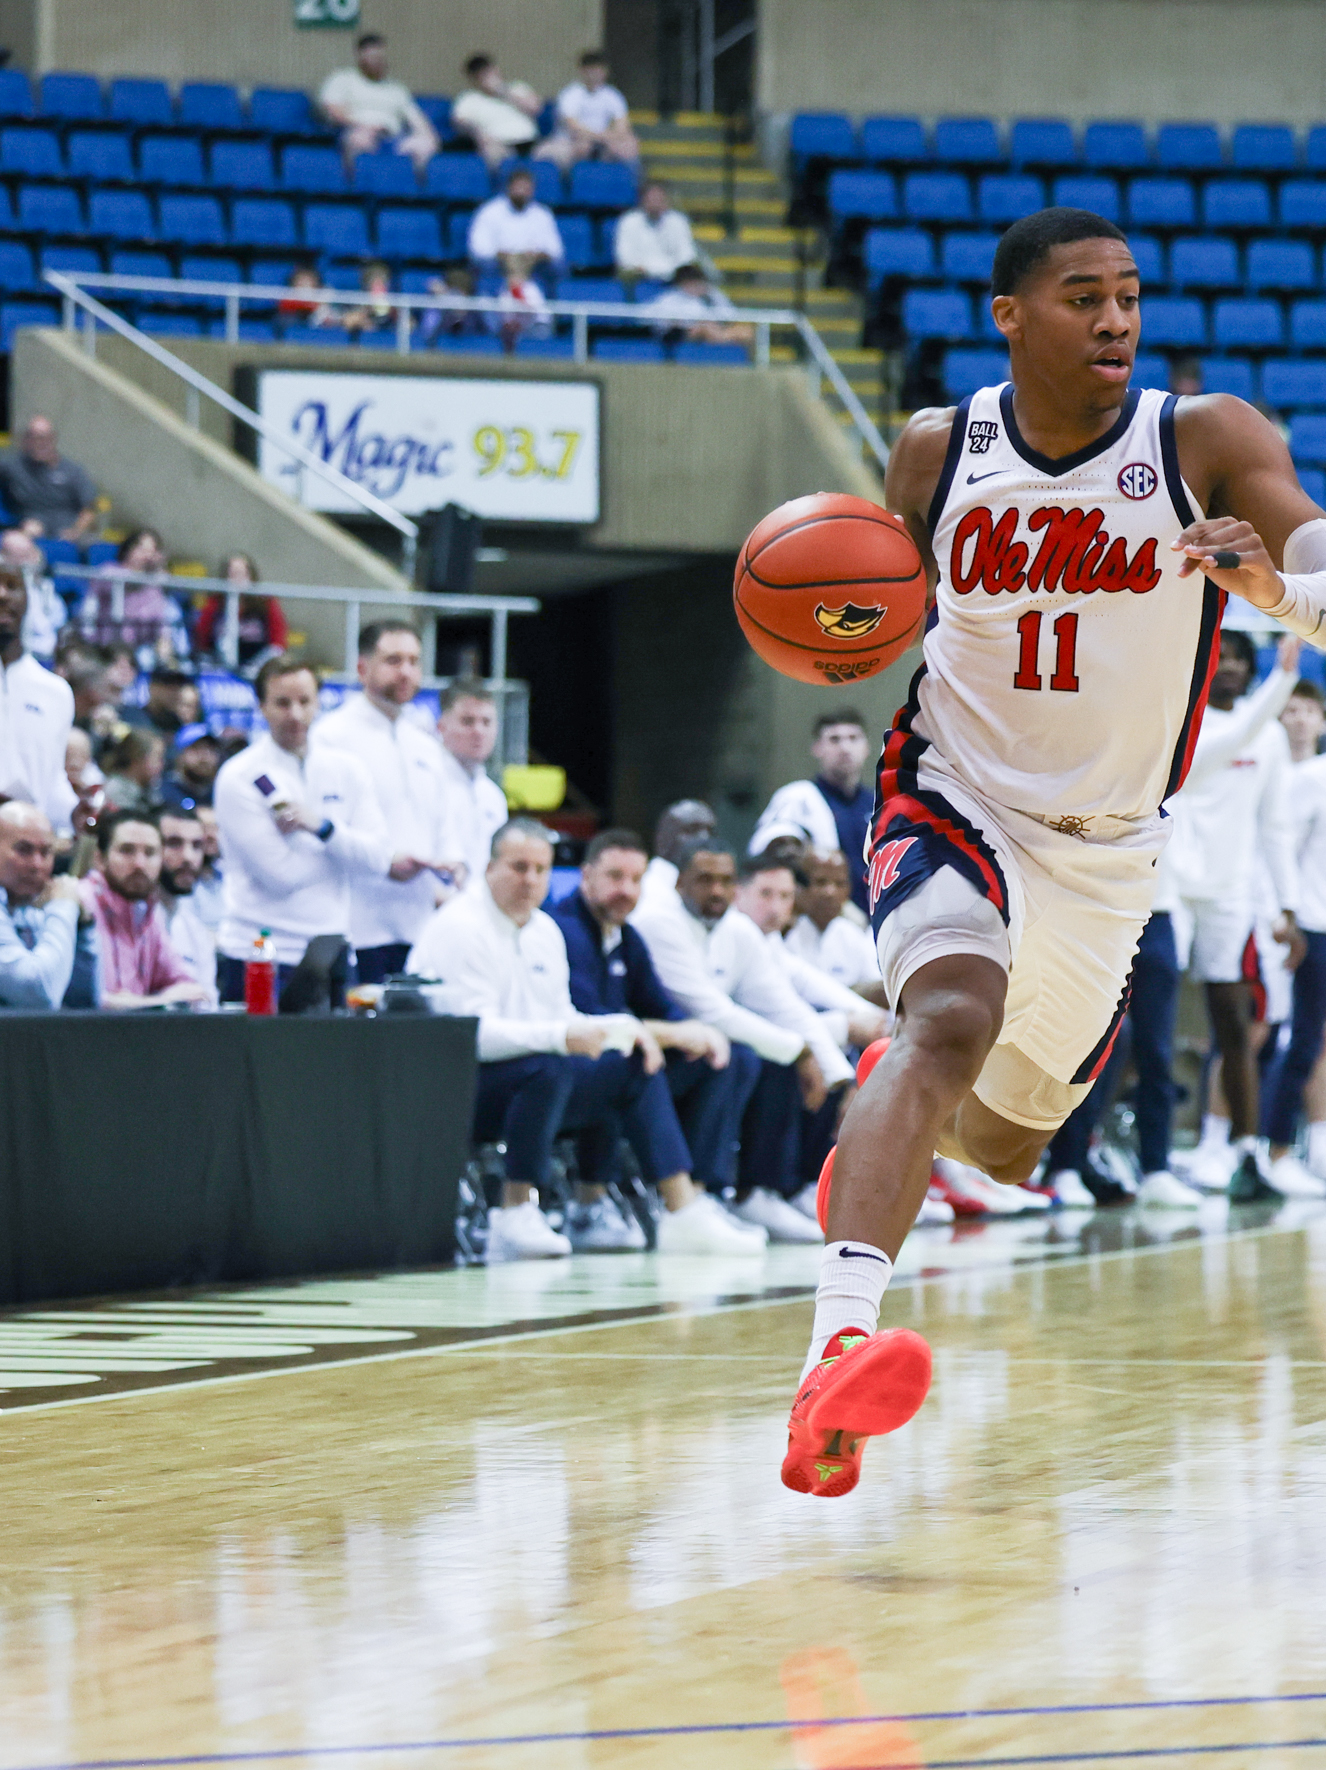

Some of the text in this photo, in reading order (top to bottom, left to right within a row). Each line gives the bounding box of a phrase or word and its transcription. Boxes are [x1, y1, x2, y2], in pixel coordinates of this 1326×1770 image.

[971, 423, 998, 438] BALL
[971, 437, 988, 451] 24
[278, 398, 581, 500] Magic 93.7
[1120, 465, 1156, 498] SEC
[950, 506, 1162, 595] Ole Miss
[813, 657, 880, 673] adidas
[1014, 610, 1079, 692] 11
